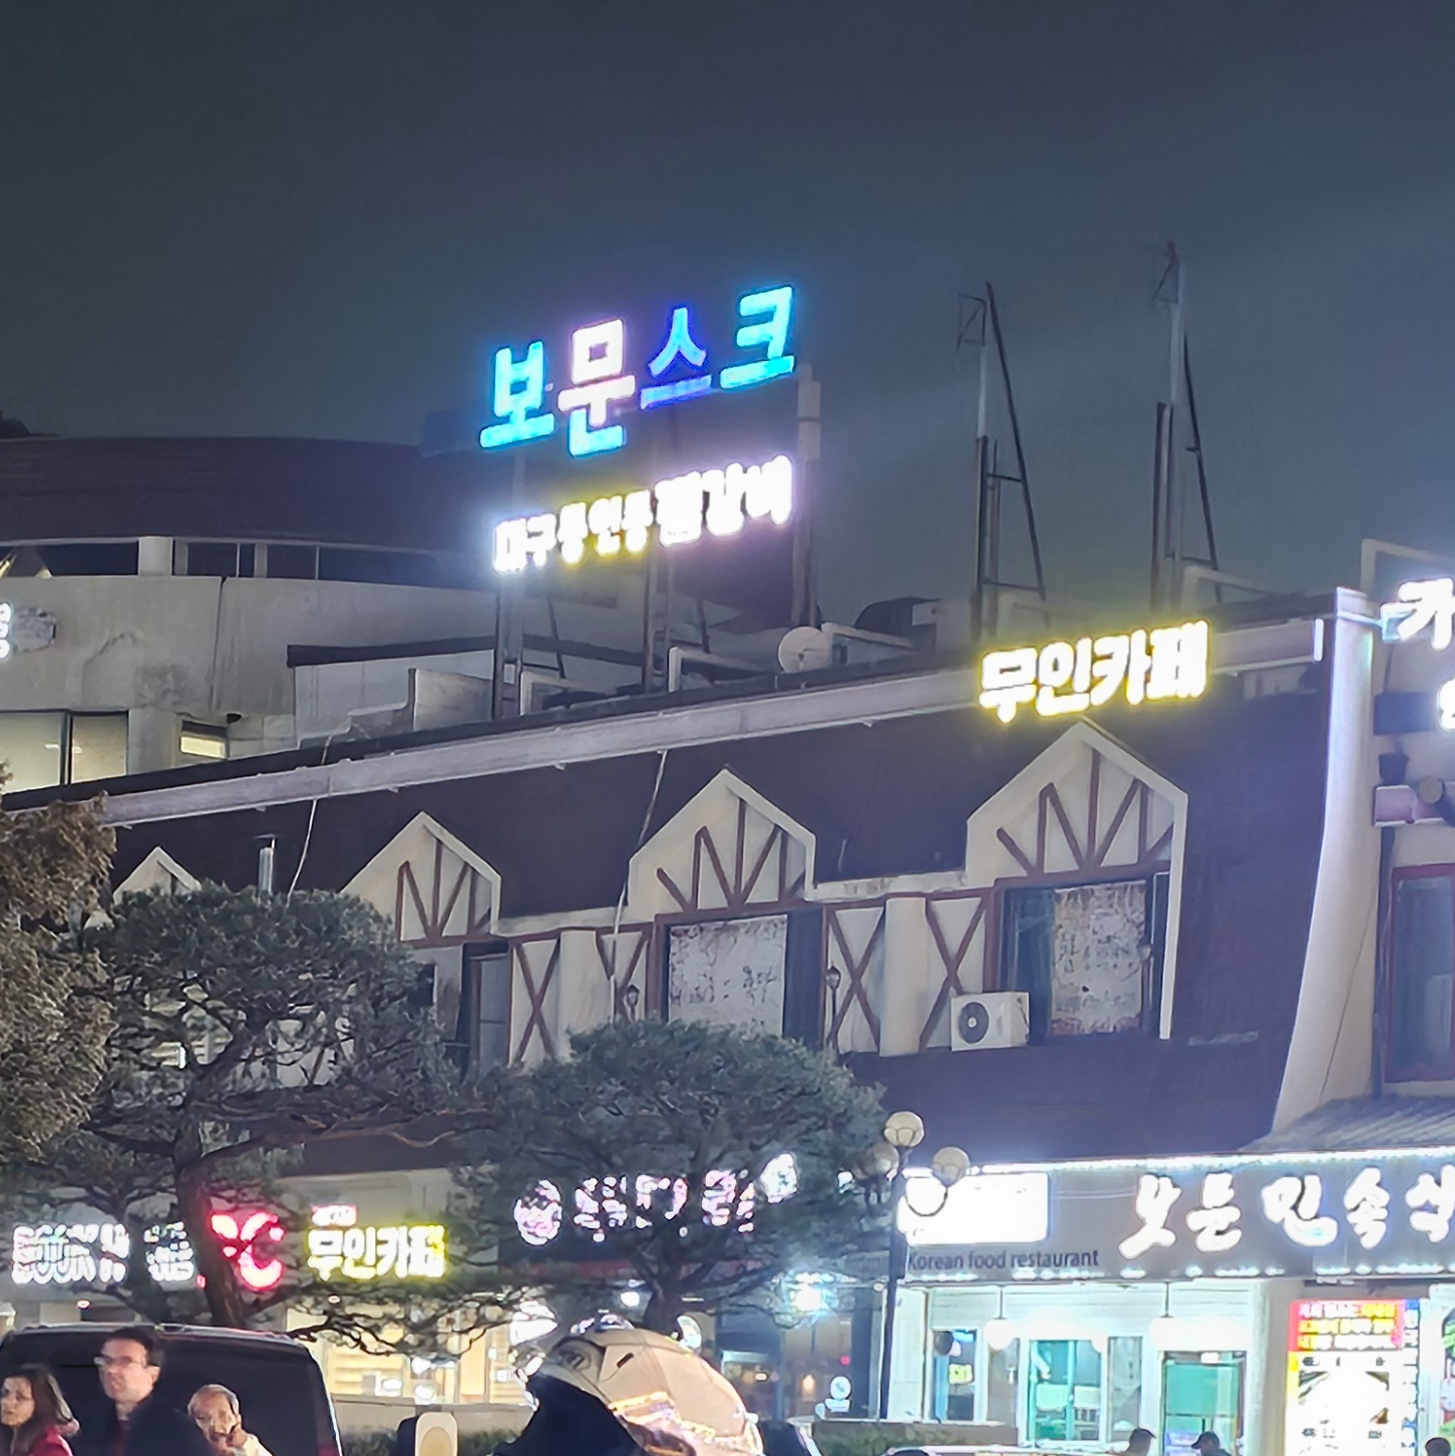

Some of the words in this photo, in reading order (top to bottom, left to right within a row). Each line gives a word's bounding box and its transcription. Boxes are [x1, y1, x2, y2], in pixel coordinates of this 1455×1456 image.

[479, 286, 795, 457] 보문스크
[978, 620, 1209, 723] 무인카페
[907, 1252, 964, 1270] Korean
[968, 1251, 1006, 1269] food
[1010, 1250, 1099, 1268] restaurant
